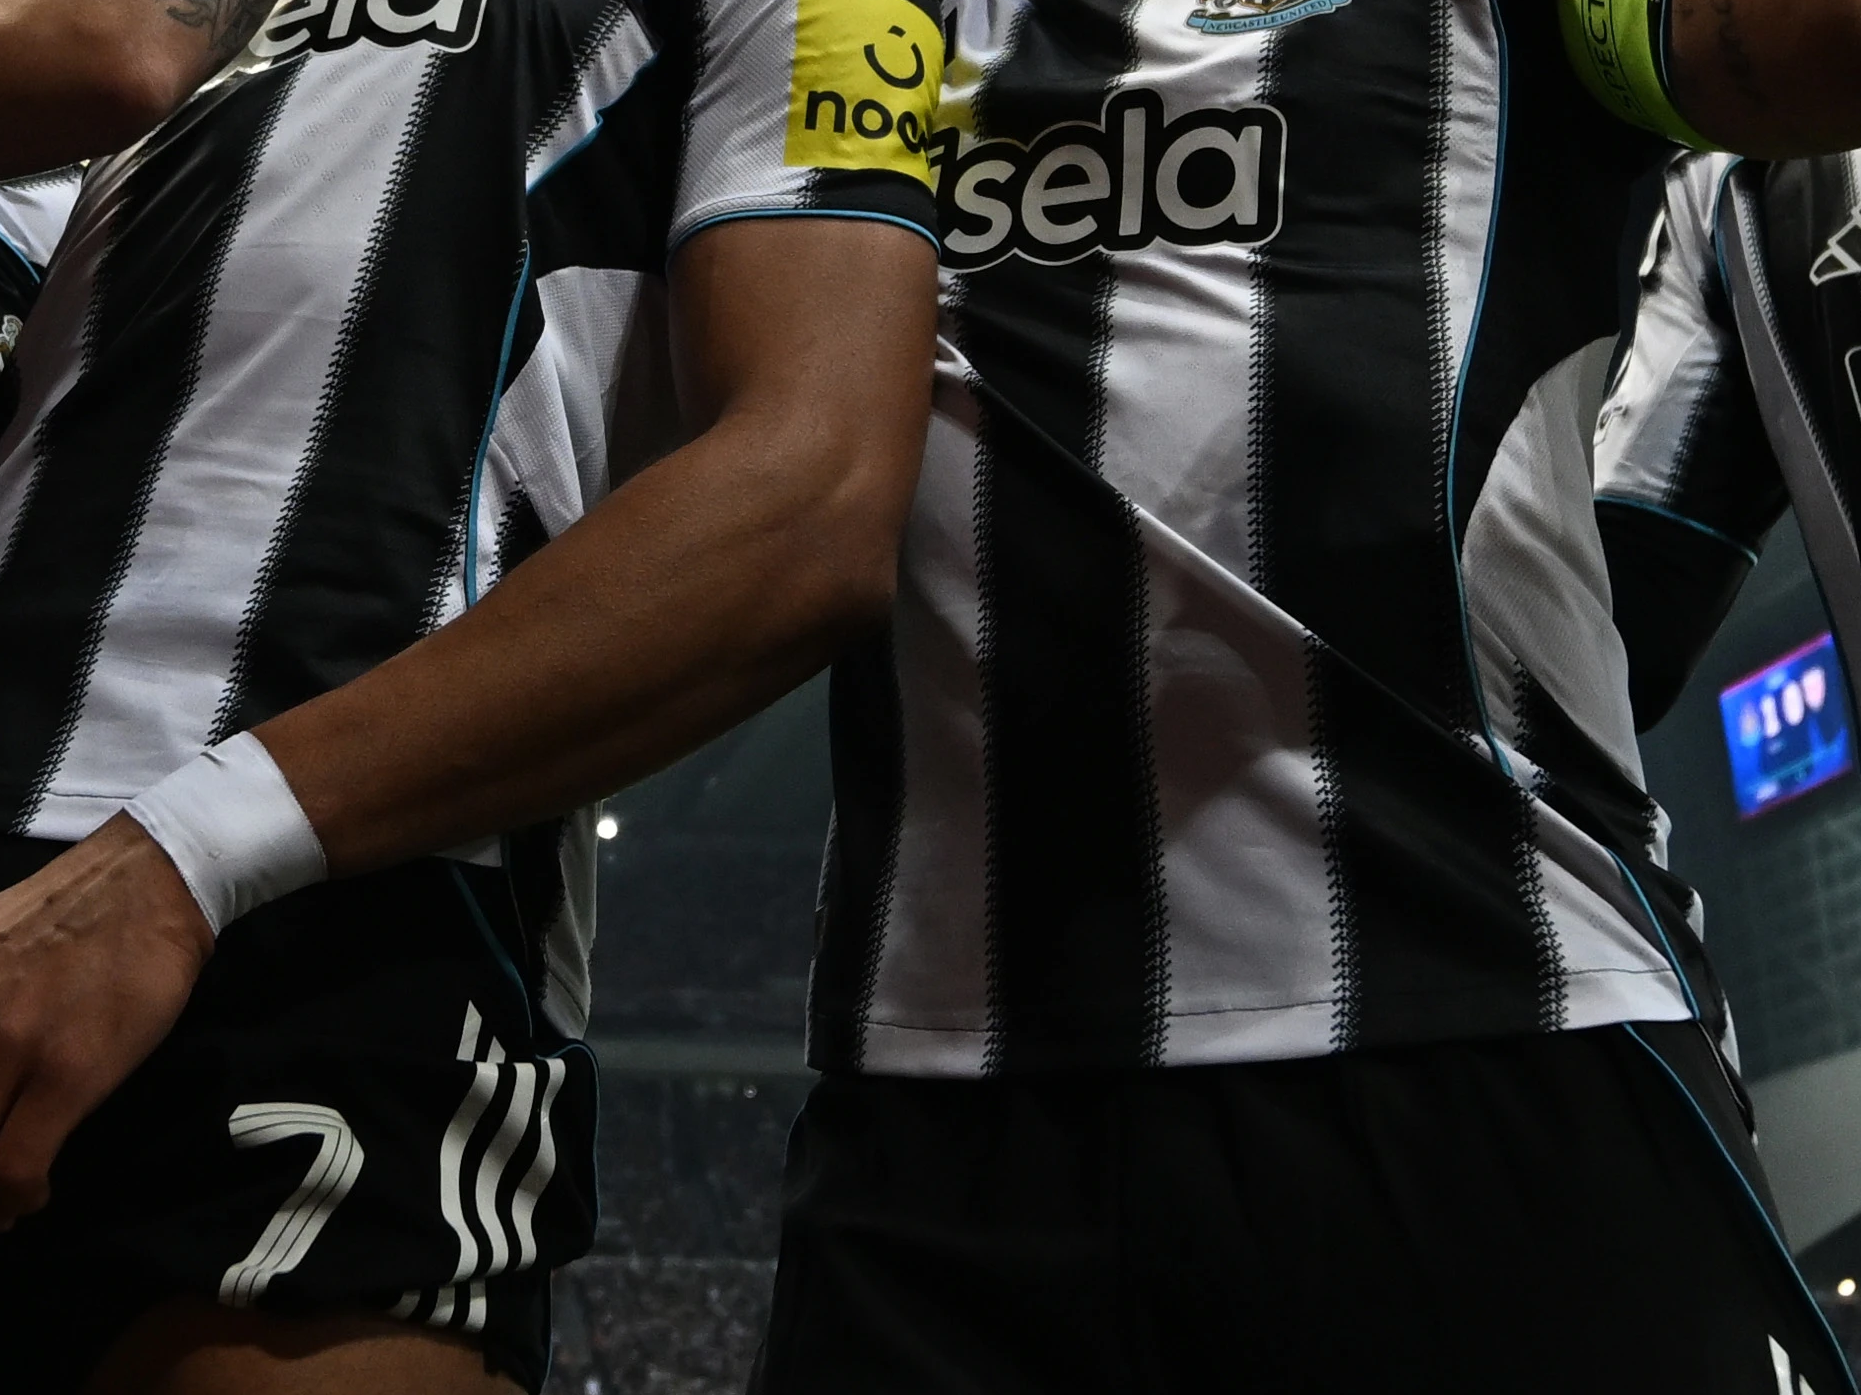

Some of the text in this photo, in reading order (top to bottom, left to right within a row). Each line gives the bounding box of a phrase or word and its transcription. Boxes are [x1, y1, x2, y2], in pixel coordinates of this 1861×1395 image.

[1208, 0, 1328, 32] NEWCASTLE UNITED
[804, 90, 928, 155] noo
[943, 106, 1263, 255] sela
[218, 1101, 365, 1307] 7
